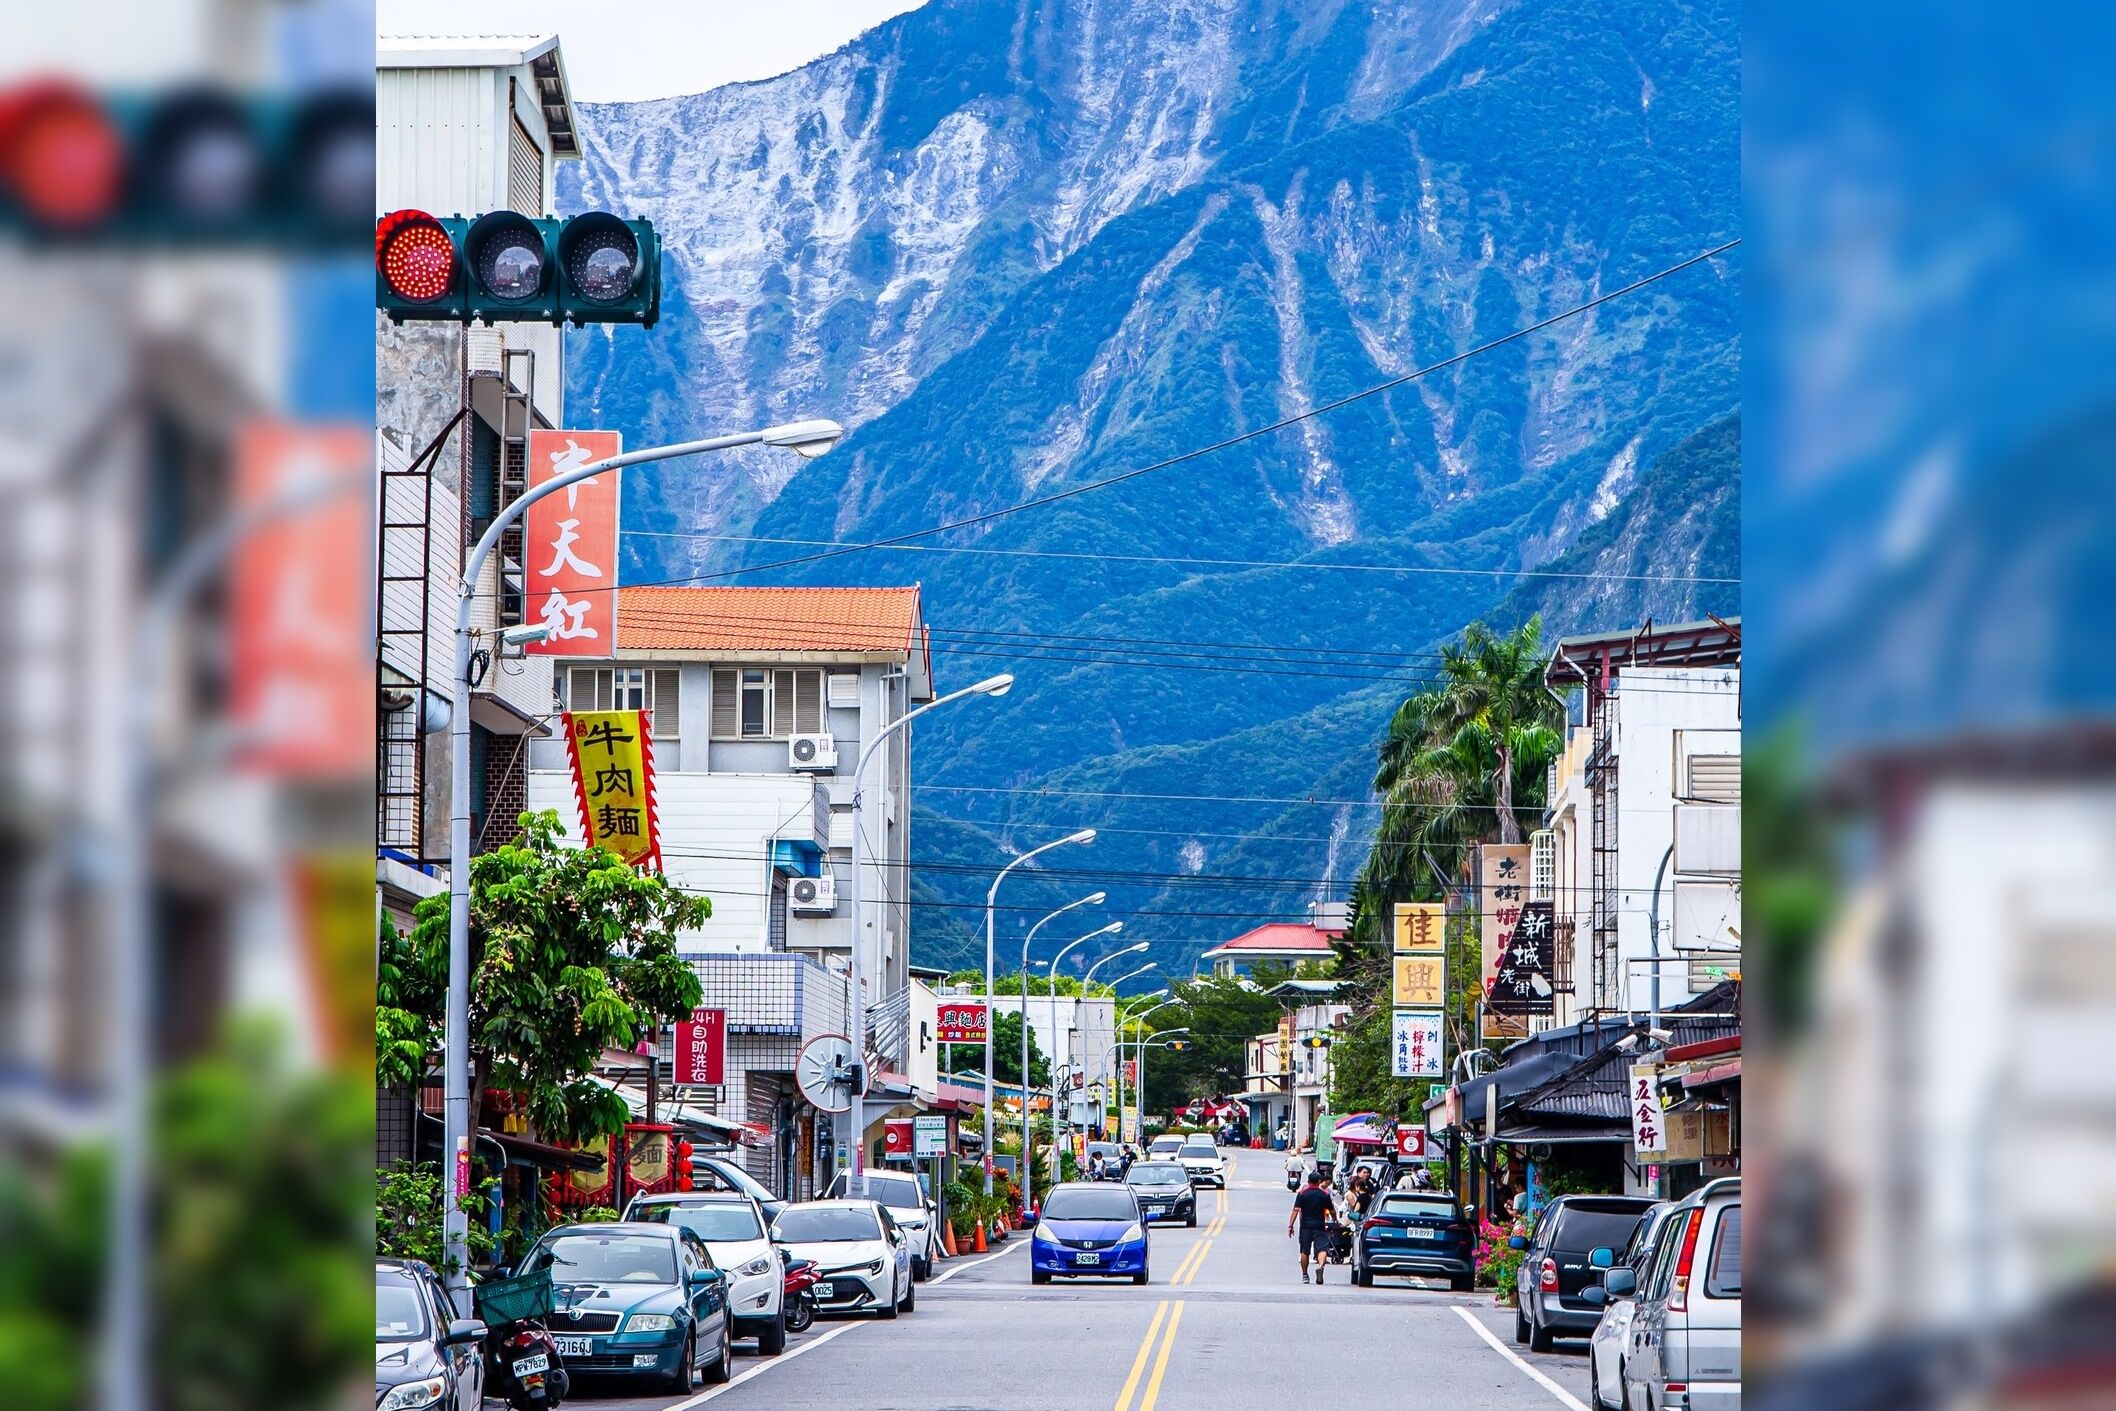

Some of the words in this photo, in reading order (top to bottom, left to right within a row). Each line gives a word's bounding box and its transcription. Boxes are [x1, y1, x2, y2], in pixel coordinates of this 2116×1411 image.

[583, 720, 641, 839] 牛肉麵
[1402, 908, 1437, 1000] 佳興
[1513, 910, 1550, 970] 新城
[1500, 967, 1530, 998] 老街
[937, 1010, 986, 1028] 興麵店
[691, 1025, 707, 1082] 自助洗衣
[1411, 1030, 1426, 1073] 檸檬汁
[1634, 1079, 1659, 1148] 五金行
